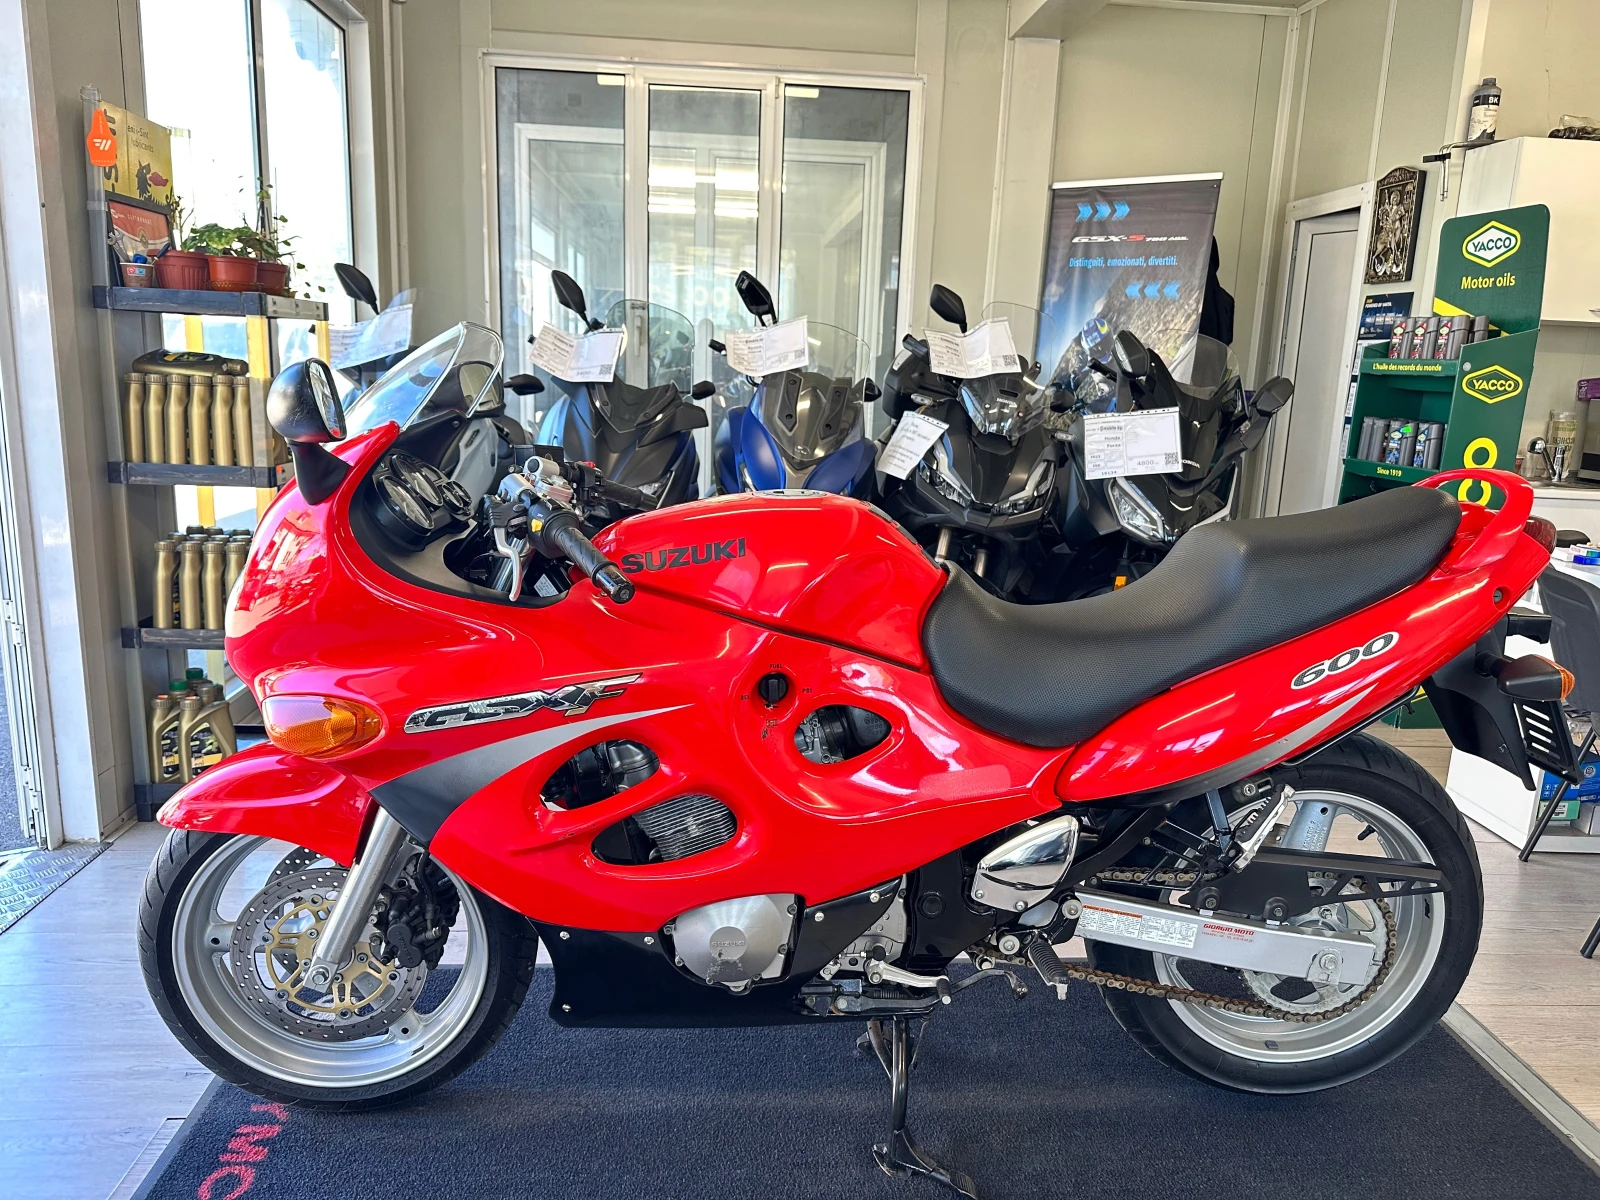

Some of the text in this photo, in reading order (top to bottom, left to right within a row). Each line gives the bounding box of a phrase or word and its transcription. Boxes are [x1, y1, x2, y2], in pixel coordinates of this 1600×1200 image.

[1488, 96, 1499, 104] BK
[1472, 236, 1512, 252] YACCO
[1069, 255, 1178, 269] Distinguiti, emozionati, divertiti.
[1460, 272, 1516, 290] Motor oils
[1373, 363, 1389, 371] L'huile
[1389, 363, 1398, 371] des
[1423, 364, 1442, 372] monde
[1472, 379, 1515, 392] YACCO
[1377, 466, 1390, 476] Since
[620, 537, 746, 574] SUZUKI
[1291, 631, 1399, 690] 600
[1203, 923, 1233, 933] GIORGIO
[1233, 928, 1255, 936] MOTO
[711, 940, 746, 948] SUZUKI
